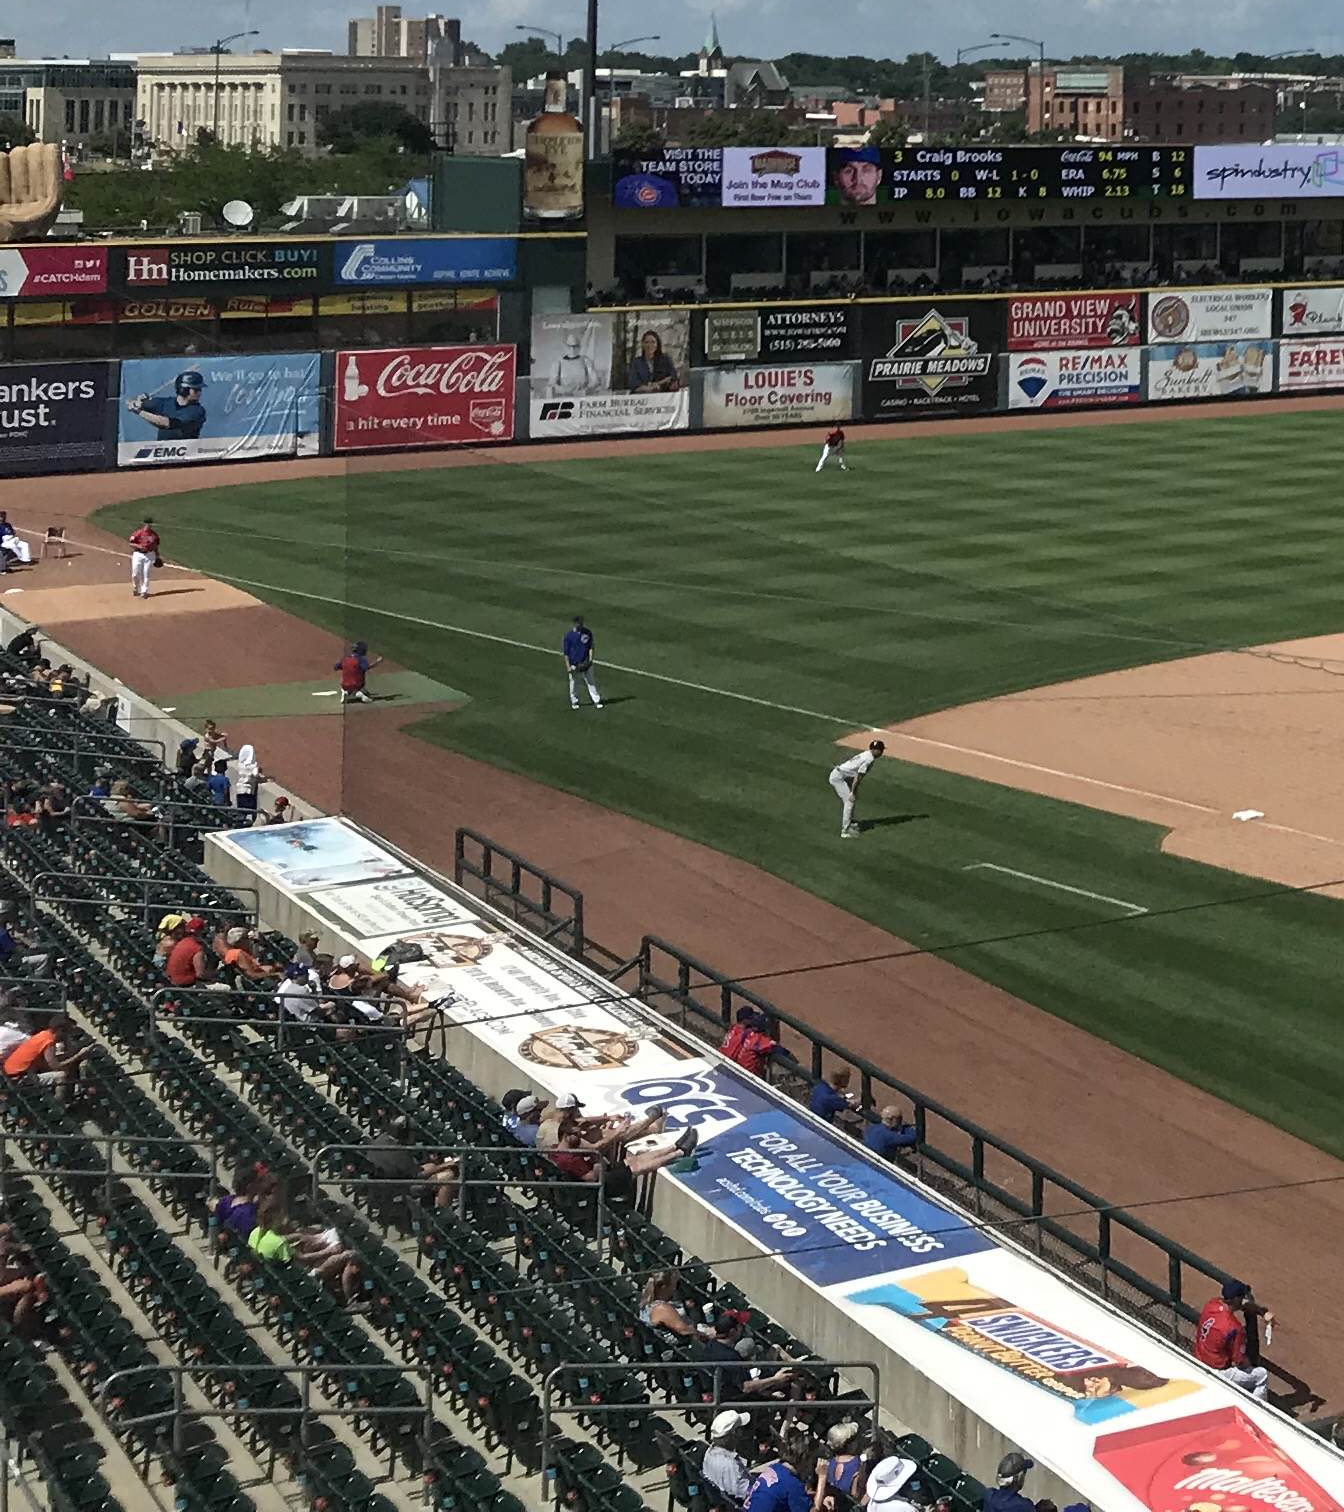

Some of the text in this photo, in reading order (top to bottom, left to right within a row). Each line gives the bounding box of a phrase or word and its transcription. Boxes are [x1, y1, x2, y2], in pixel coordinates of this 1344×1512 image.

[664, 148, 721, 160] VISIT THE
[916, 150, 1003, 165] Craig Brooks
[1171, 150, 1185, 162] 12
[641, 161, 721, 172] TEAM STORE
[680, 173, 721, 184] TODAY
[893, 170, 1000, 181] STARTS W-L
[1061, 169, 1127, 180] ERA 6.75
[726, 179, 820, 192] Join the Mug Club
[893, 187, 977, 199] IP BB
[1061, 186, 1130, 198] WHIP 2.13
[171, 265, 317, 282] Homemakers.com
[1011, 298, 1110, 320] GRAND VIEW
[766, 311, 845, 326] ATTORNEYS
[1013, 317, 1107, 337] UNIVERSITY
[874, 357, 986, 377] PRAIRIE MEADOWS
[1058, 353, 1130, 372] RE/MAX
[376, 351, 513, 398] Coca-Cola
[743, 369, 815, 391] LOUIE'S
[1058, 370, 1130, 385] PRECISION
[725, 390, 832, 407] Floor Covering
[427, 413, 461, 426] time
[153, 447, 188, 458] EMC
[725, 1147, 827, 1223] TECHNOLOGY
[815, 1211, 888, 1252] NEEDS
[750, 1131, 793, 1154] FOR
[779, 1151, 817, 1175] ALL
[809, 1169, 868, 1211] YOUR
[852, 1198, 946, 1254] BUSINESS
[968, 1314, 1110, 1371] SNICKERS
